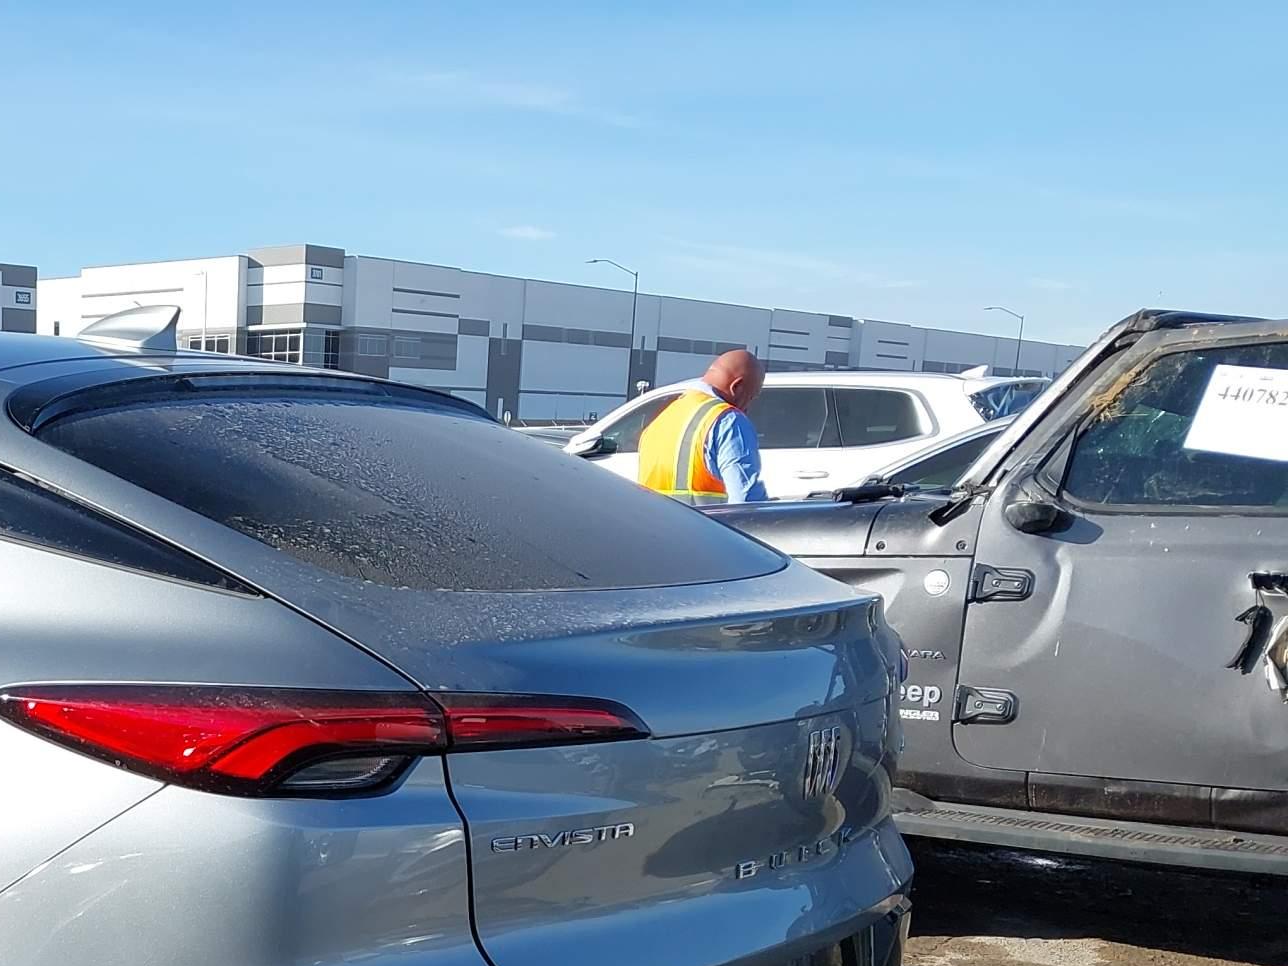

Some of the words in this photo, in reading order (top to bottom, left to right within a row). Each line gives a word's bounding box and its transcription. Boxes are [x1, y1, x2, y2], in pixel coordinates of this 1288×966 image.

[908, 650, 946, 660] ARA
[491, 822, 634, 853] ENVISTA
[735, 827, 852, 879] BUICK
